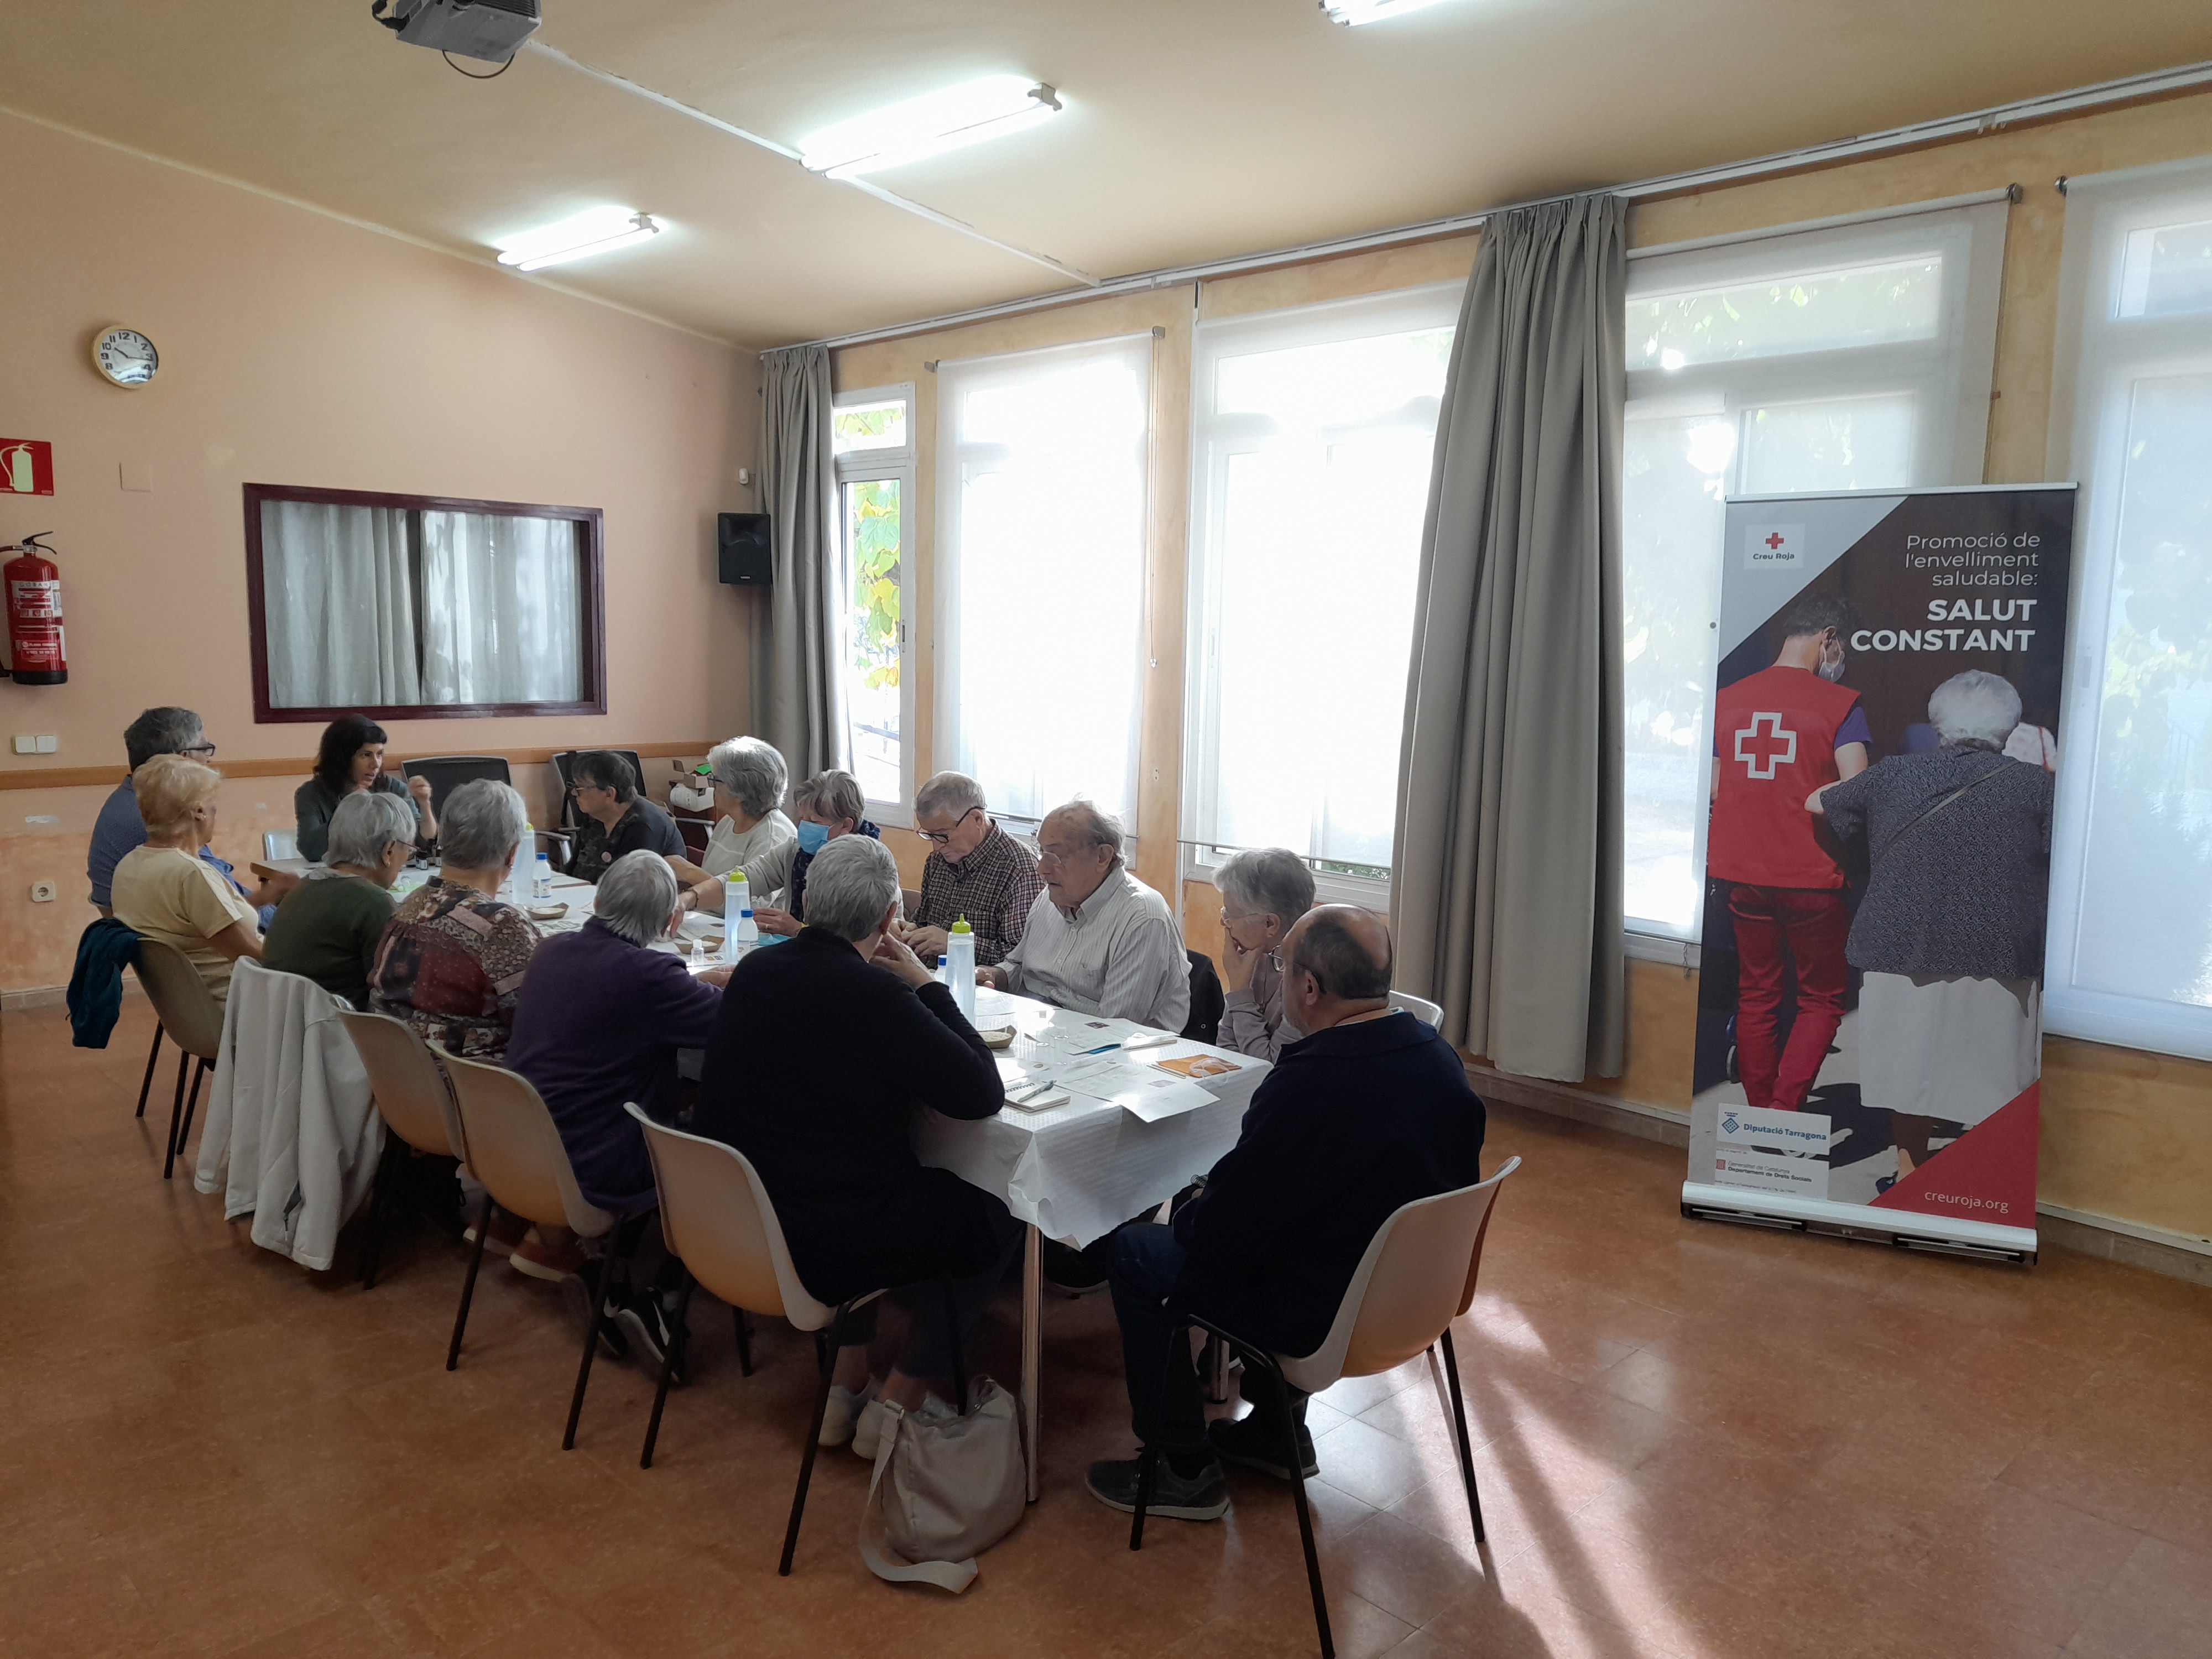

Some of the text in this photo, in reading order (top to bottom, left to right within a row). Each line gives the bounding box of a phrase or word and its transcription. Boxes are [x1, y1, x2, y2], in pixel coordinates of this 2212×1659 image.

[1907, 531, 2041, 549] Promoció de
[1776, 552, 1794, 560] Roja
[1906, 551, 2039, 568] l'envelliment
[1932, 570, 2038, 586] saludable:
[1927, 599, 2038, 622] SALUT
[1850, 629, 2036, 651] CONSTANT
[1744, 1124, 1827, 1140] Diputació Tarragona
[1924, 1192, 2008, 1214] creuroja.org
